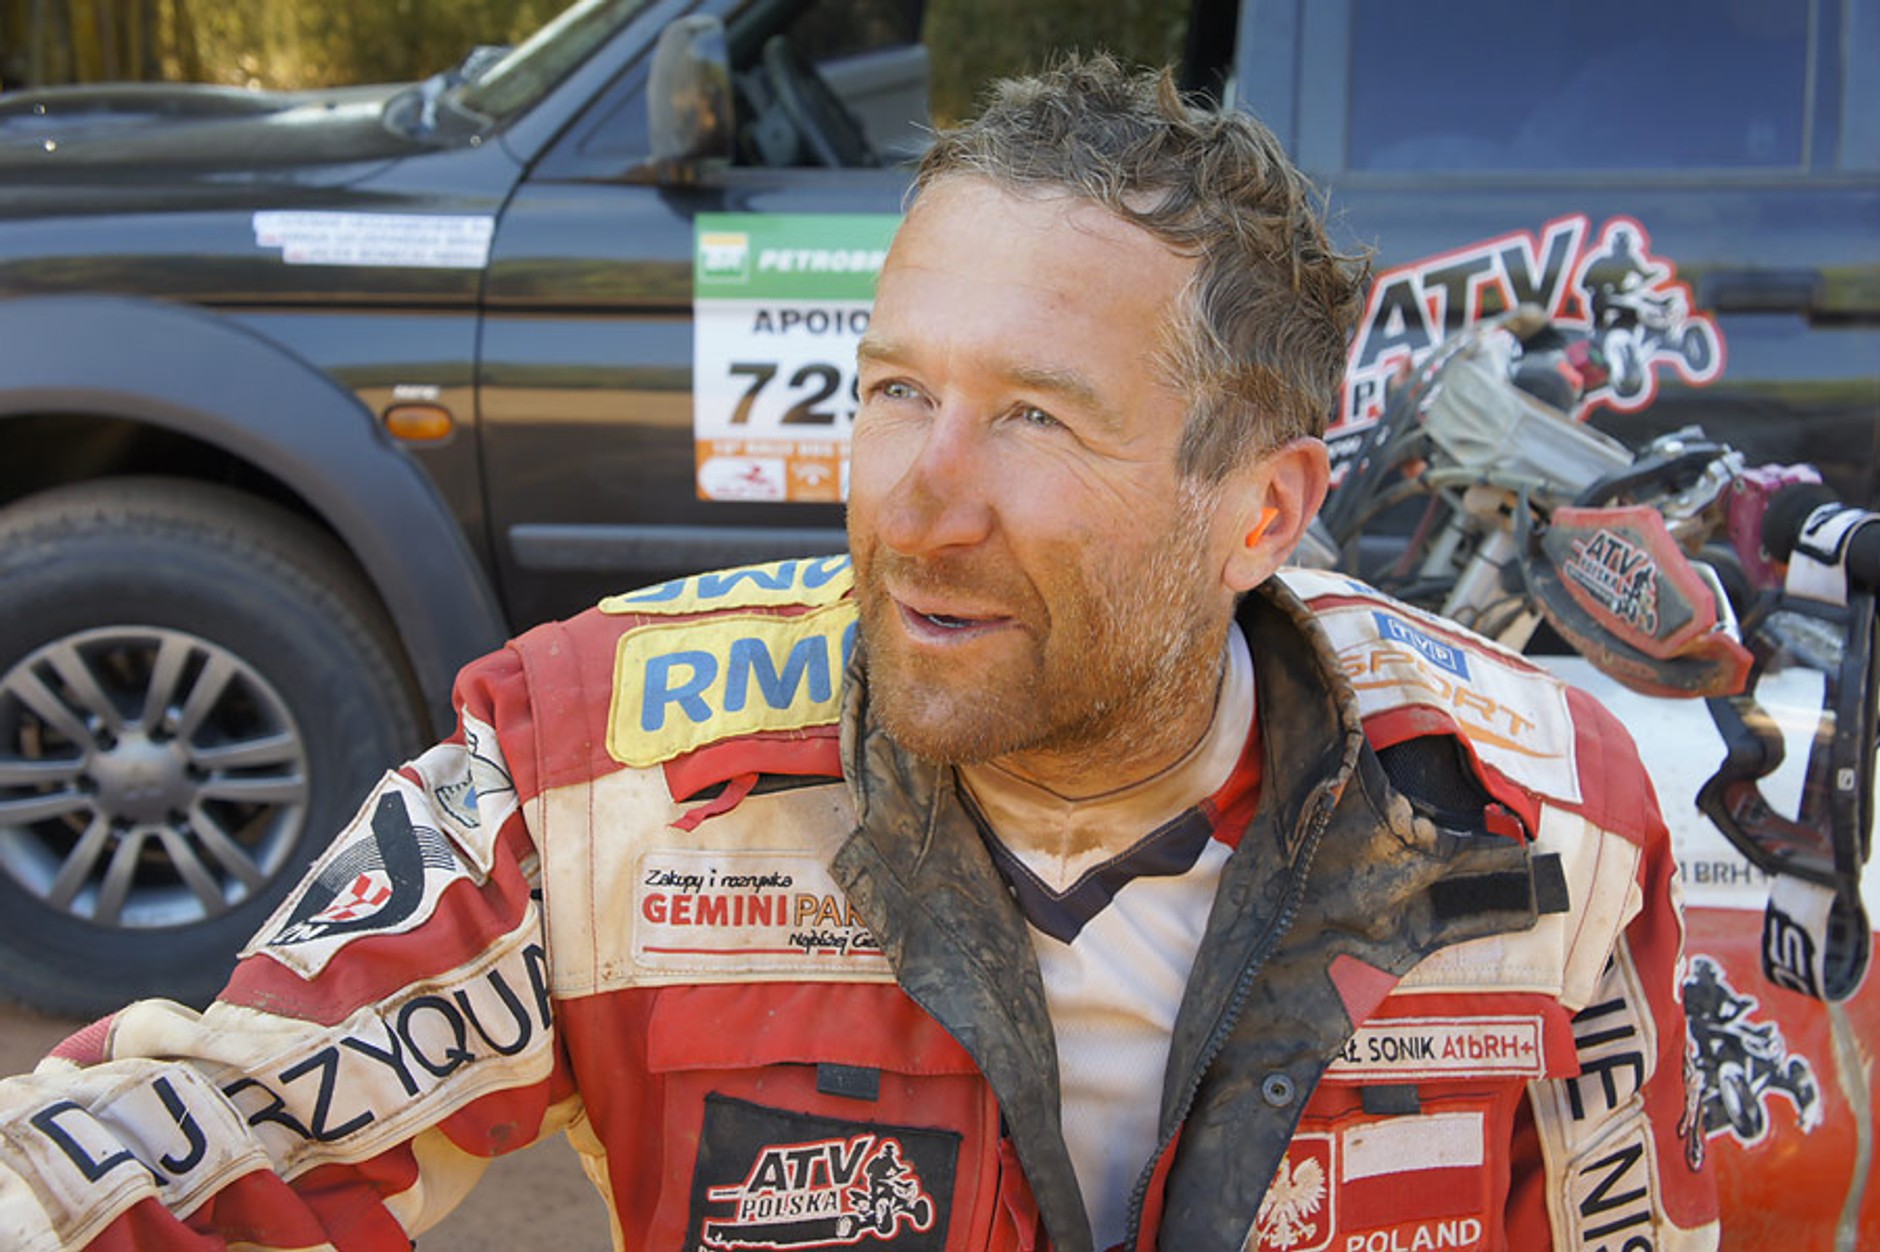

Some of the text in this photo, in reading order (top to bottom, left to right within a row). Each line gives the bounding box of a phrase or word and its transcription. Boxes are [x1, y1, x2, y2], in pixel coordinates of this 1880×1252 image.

[1356, 228, 1580, 370] ATV
[753, 308, 871, 335] APOIO
[1584, 533, 1643, 577] ATV
[645, 869, 705, 893] Zakupy
[642, 892, 788, 927] GEMINI
[1367, 1036, 1436, 1063] SONIK
[747, 1136, 874, 1193] ATV
[741, 1191, 838, 1220] POLSKA
[1346, 1217, 1483, 1252] POLAND
